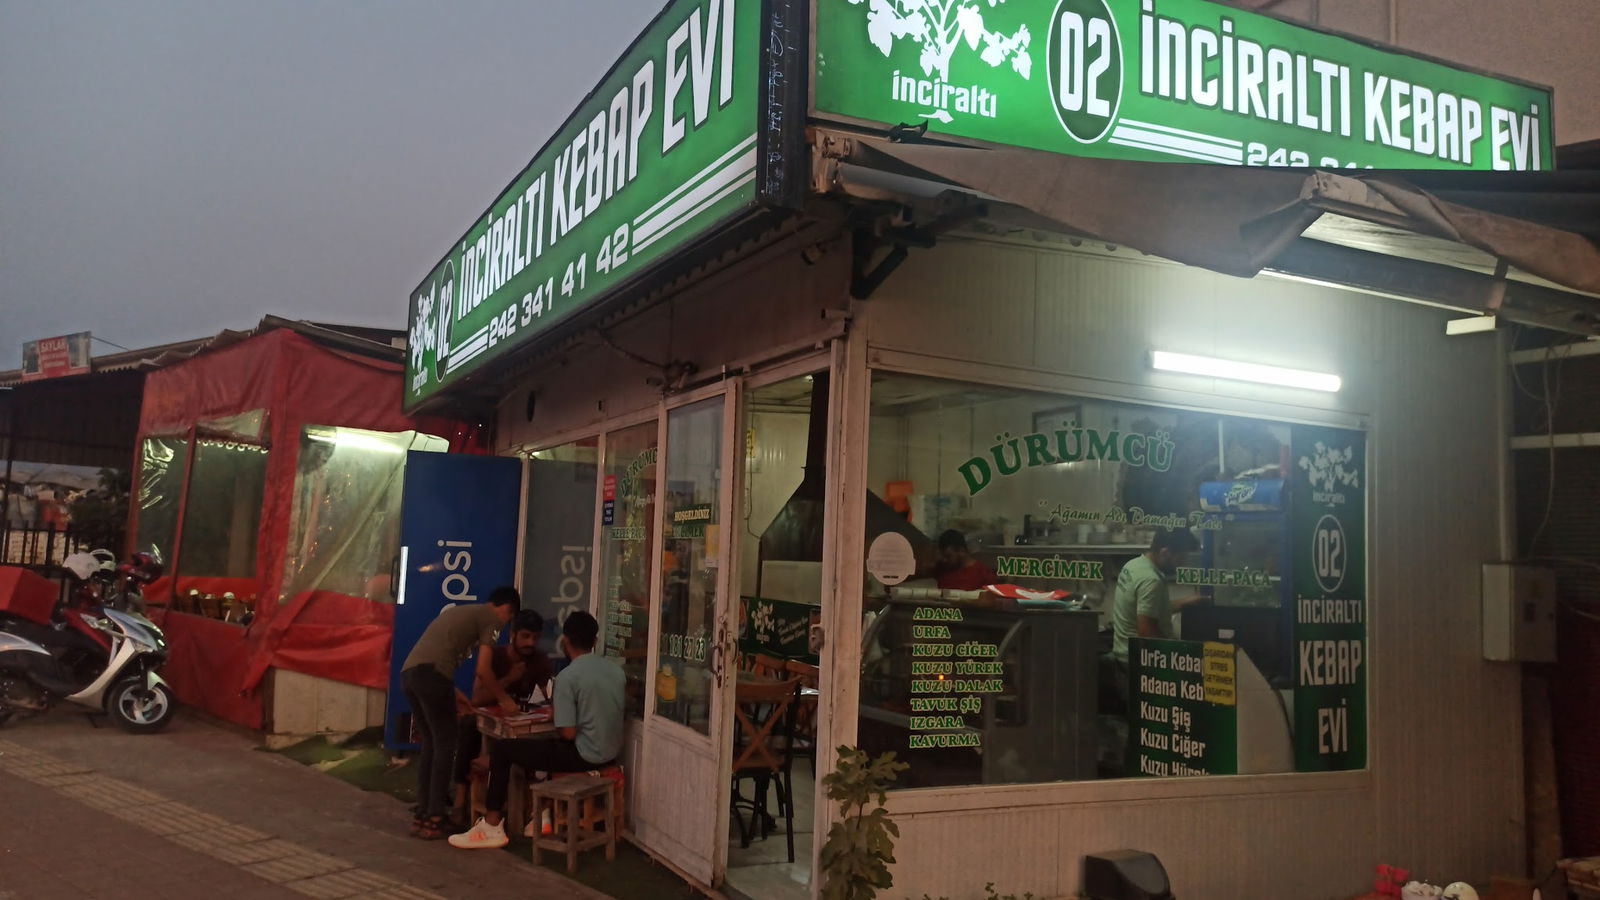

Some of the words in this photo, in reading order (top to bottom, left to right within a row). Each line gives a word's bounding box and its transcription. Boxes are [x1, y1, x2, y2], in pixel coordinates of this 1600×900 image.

[1060, 11, 1110, 117] 02
[1364, 71, 1482, 164] KEBAP
[1491, 103, 1540, 171] EVİ
[550, 59, 654, 246] KEBAP
[488, 303, 517, 348] 242
[521, 276, 554, 327] 341
[562, 253, 586, 297] 41
[596, 222, 629, 274] 42
[436, 279, 453, 362] 02
[957, 420, 1175, 496] DÜRÜMCÜ
[1318, 529, 1341, 578] 02
[997, 554, 1103, 580] MERCİMEK
[1176, 567, 1228, 586] KELLE
[913, 607, 963, 621] ADANA
[913, 625, 951, 638] URFA
[912, 644, 953, 656] KUZU
[956, 641, 998, 657] CİĞER
[1140, 648, 1167, 669] Urfa
[912, 662, 953, 674] KUZU
[955, 659, 1003, 675] YÜREK
[1300, 640, 1362, 686] KEBAP
[911, 680, 952, 693] KUZU
[955, 680, 1003, 692] DALAK
[1140, 674, 1177, 697] Adana
[1181, 679, 1204, 701] Keb
[910, 698, 957, 711] TAVUK
[960, 694, 981, 714] ŞİŞ
[1140, 701, 1168, 723] Kuzu
[1172, 706, 1191, 733] Şiş
[910, 716, 965, 729] IZGARA
[1318, 698, 1347, 754] EVİ
[909, 733, 981, 748] KAVURMA
[1140, 727, 1168, 750] Kuzu
[1172, 734, 1206, 758] Ciğer
[1140, 754, 1168, 777] Kuzu
